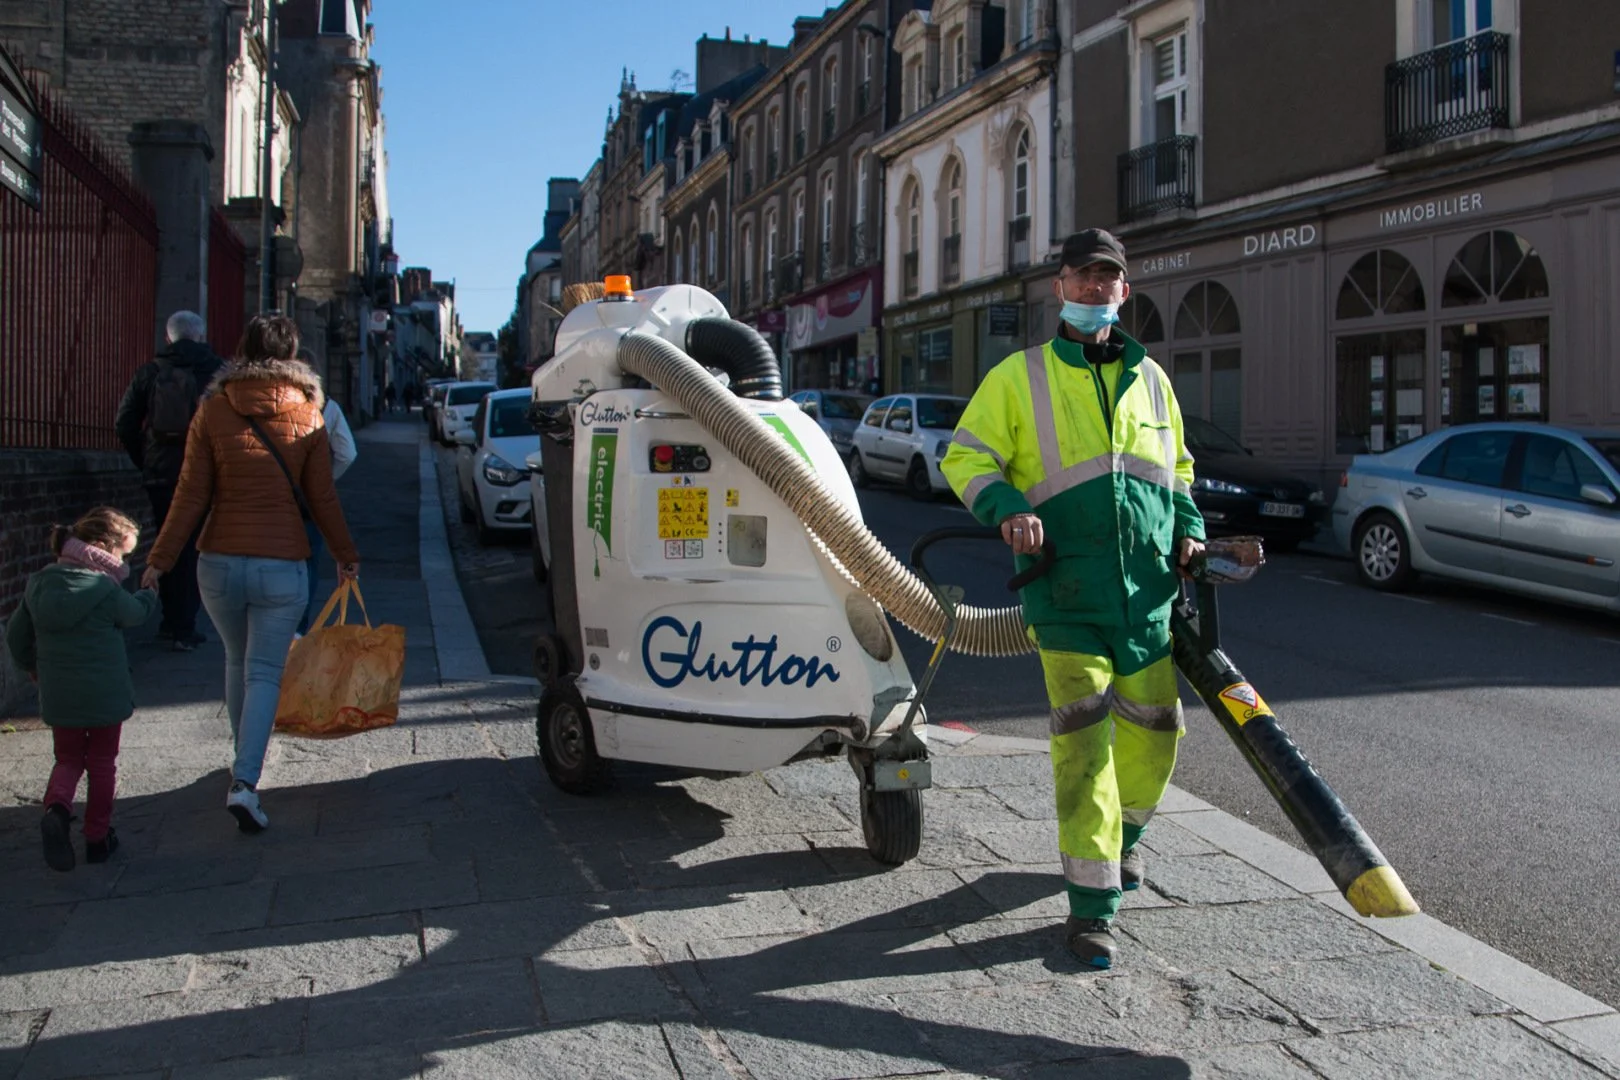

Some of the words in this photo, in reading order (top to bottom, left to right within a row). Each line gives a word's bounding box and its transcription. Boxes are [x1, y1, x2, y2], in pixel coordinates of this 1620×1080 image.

[1142, 252, 1192, 274] CABINET
[1244, 224, 1316, 256] DIARD
[1380, 193, 1483, 228] IMMOBILIER
[581, 401, 628, 427] Glutton
[593, 447, 608, 531] electric
[642, 616, 840, 688] Glutton
